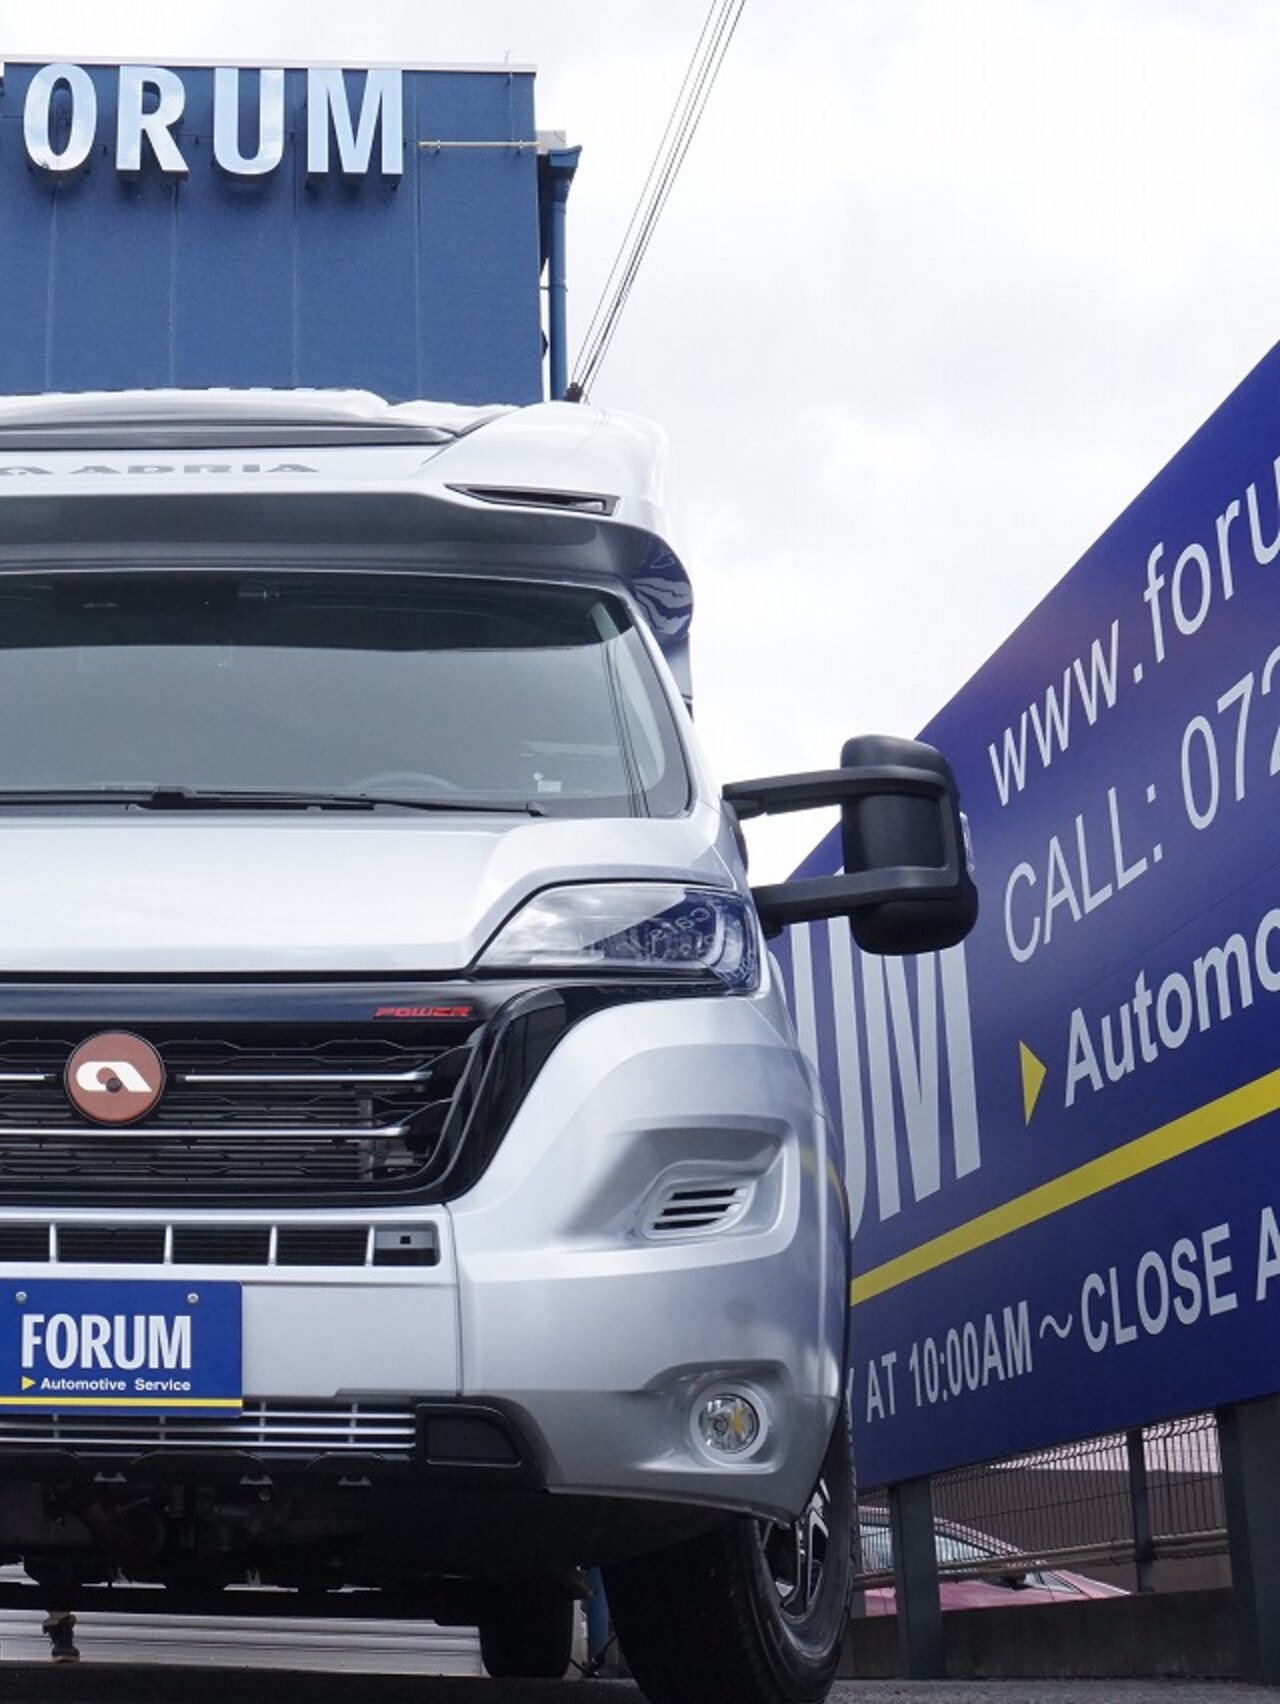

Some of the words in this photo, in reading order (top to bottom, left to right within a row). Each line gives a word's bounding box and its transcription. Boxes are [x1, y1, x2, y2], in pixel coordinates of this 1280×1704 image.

[70, 463, 319, 475] ADRIA
[375, 1006, 470, 1018] POWER
[21, 1313, 192, 1370] FORUM
[40, 1377, 127, 1391] Automotive
[134, 1378, 191, 1391] Service
[867, 1351, 897, 1423] AT
